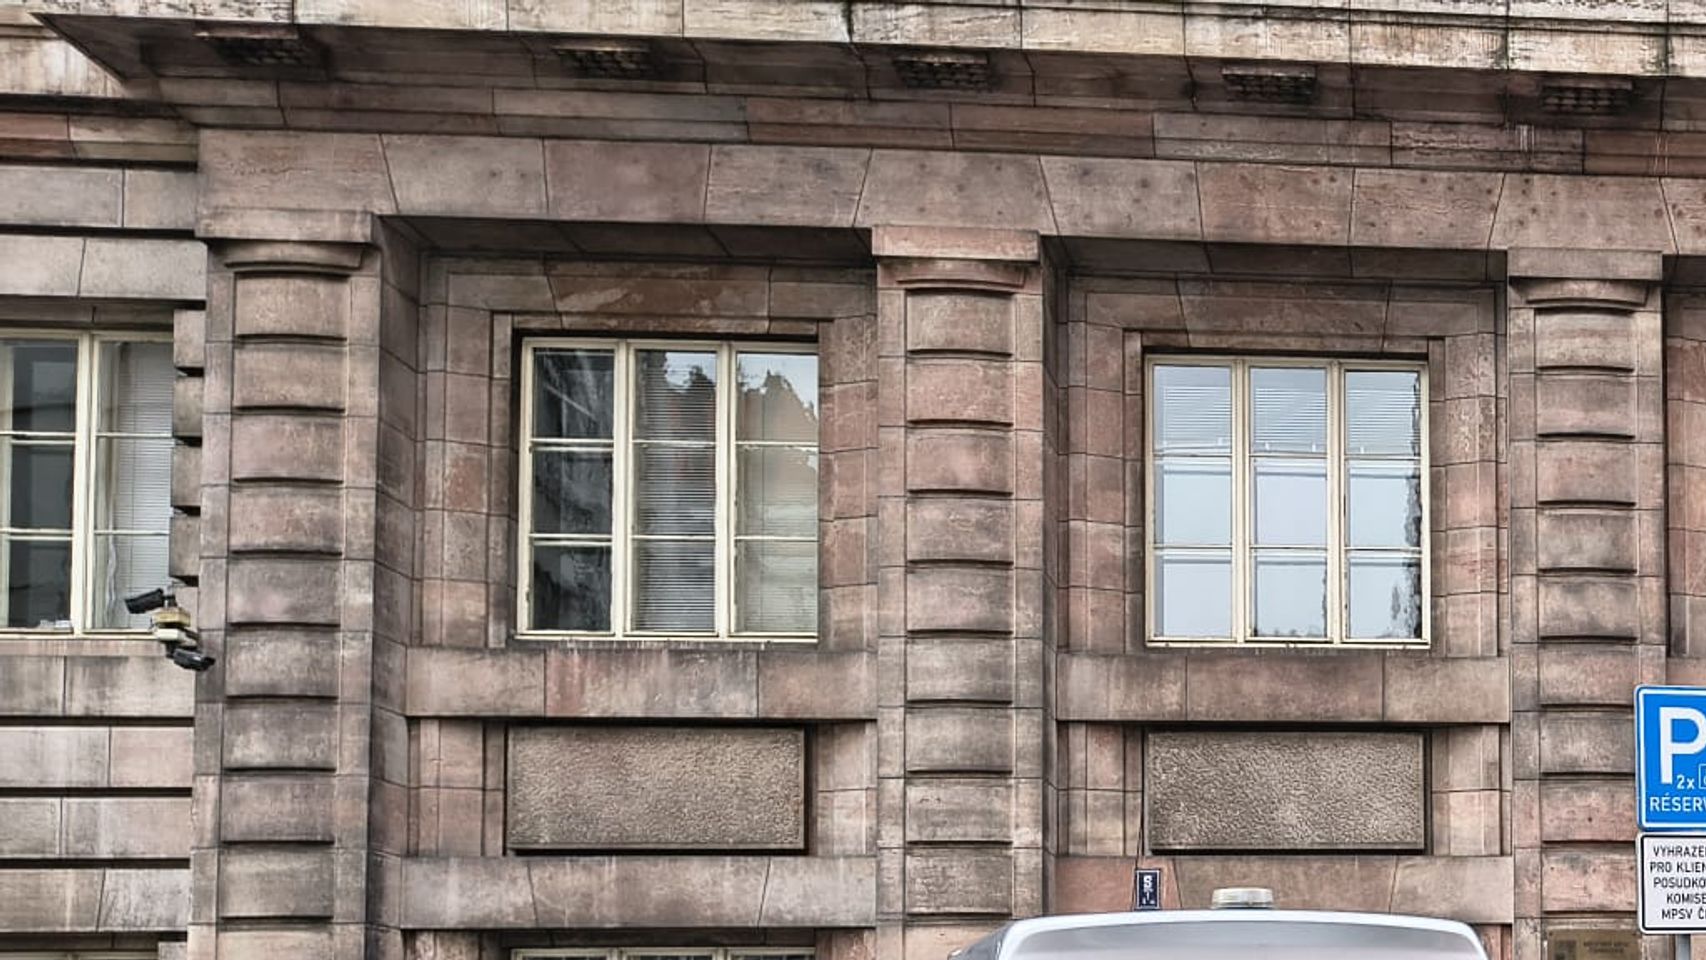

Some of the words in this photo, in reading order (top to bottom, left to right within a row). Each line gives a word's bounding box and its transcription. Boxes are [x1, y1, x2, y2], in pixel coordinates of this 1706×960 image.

[1677, 773, 1696, 790] 2x
[1649, 861, 1673, 873] PRO
[1661, 908, 1694, 920] MPSV
